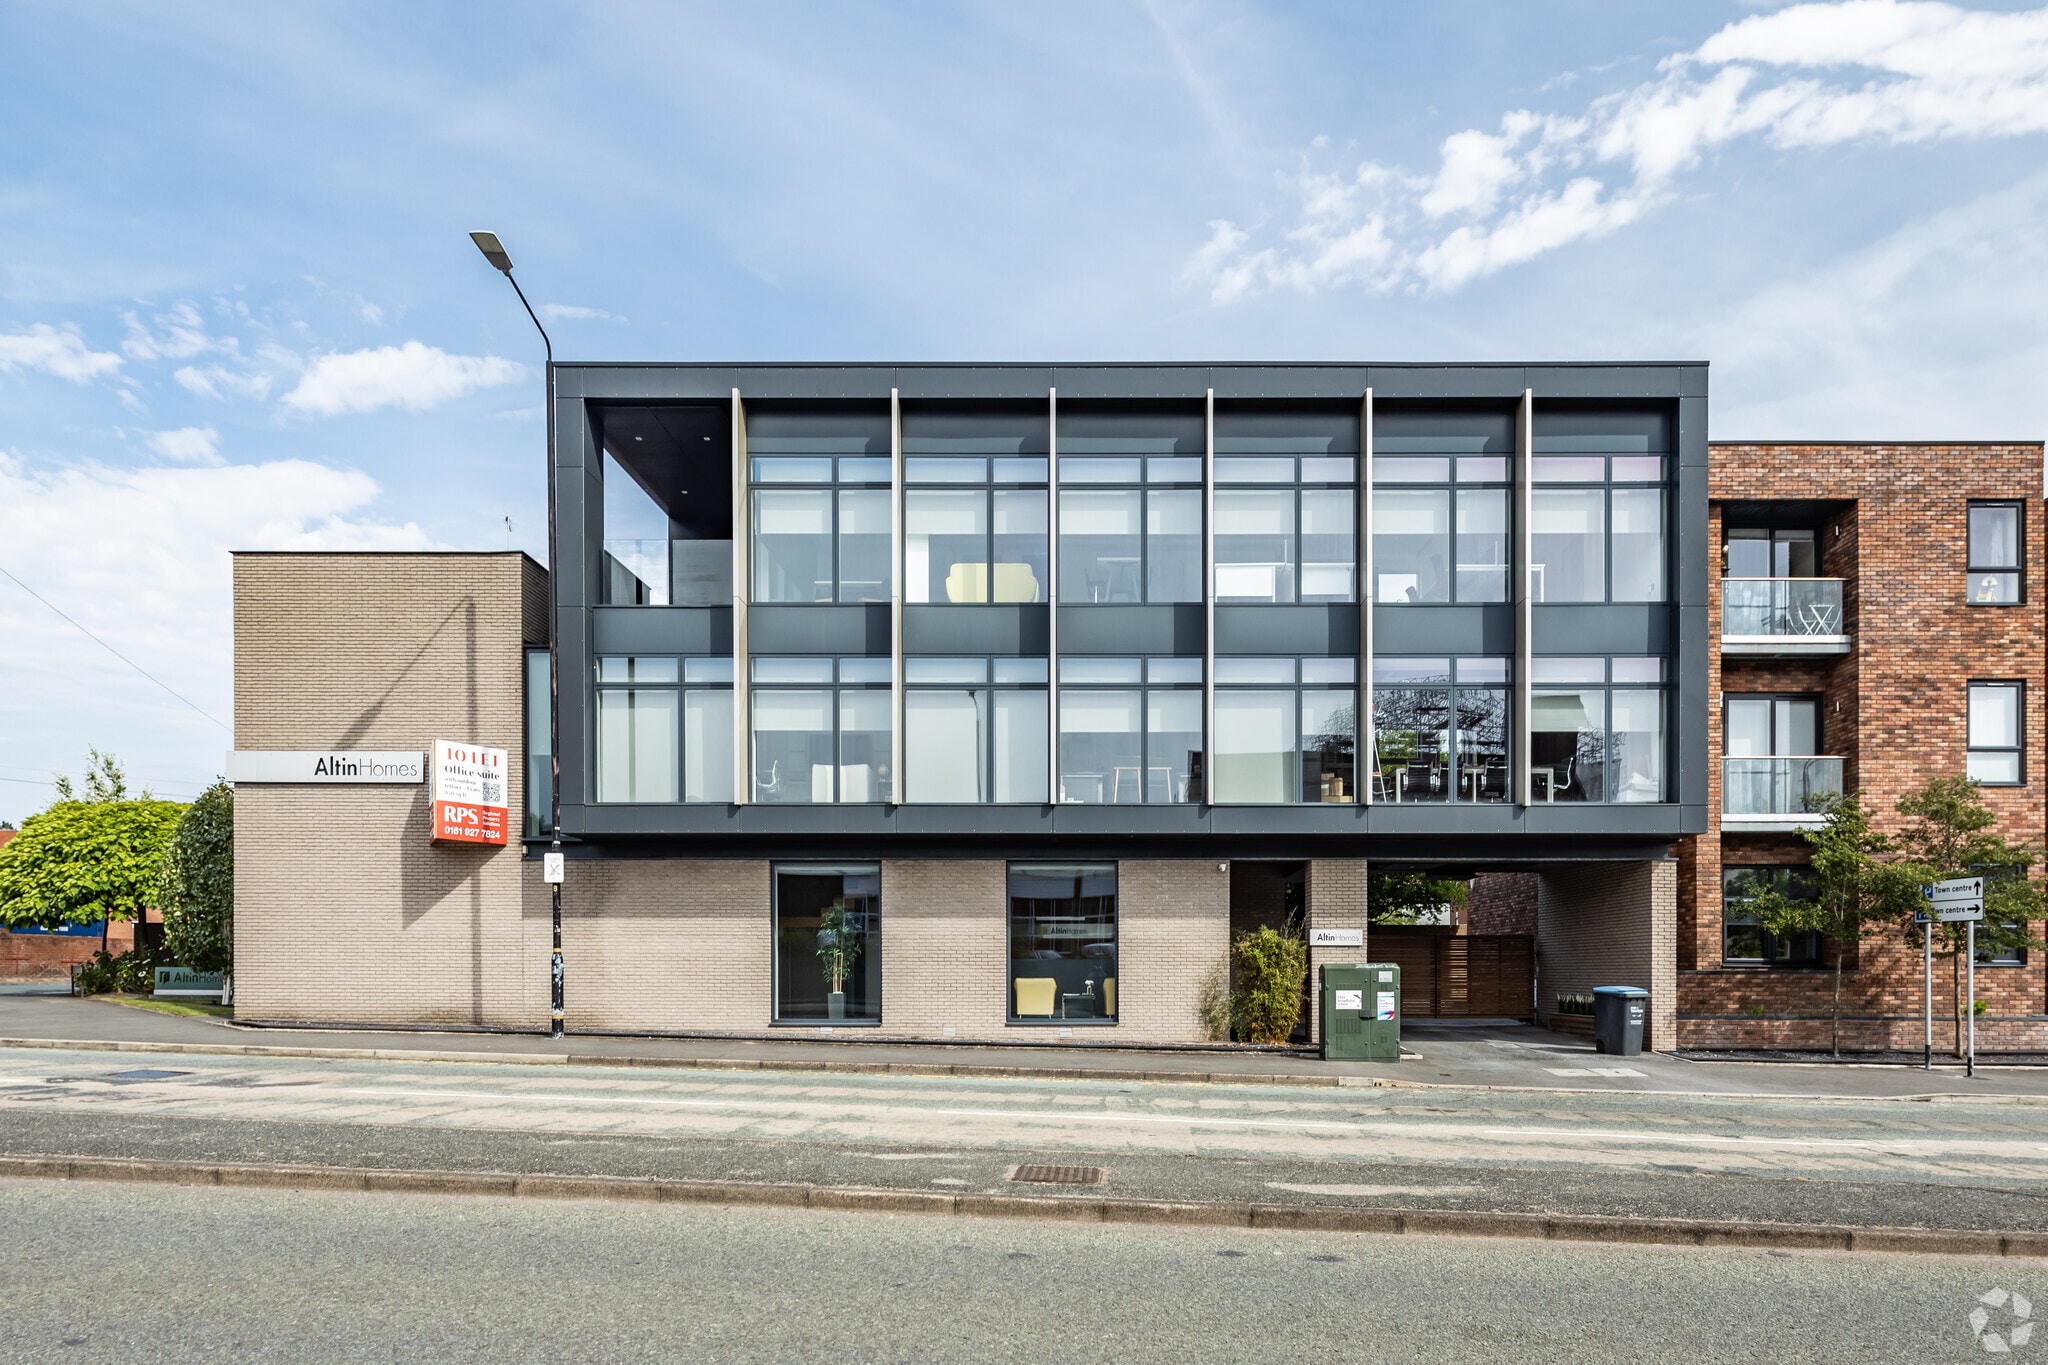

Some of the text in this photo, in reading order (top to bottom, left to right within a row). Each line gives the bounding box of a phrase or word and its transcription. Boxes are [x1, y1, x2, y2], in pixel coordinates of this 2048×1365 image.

[314, 755, 418, 776] AltinHomes
[444, 765, 500, 780] Office suite
[444, 825, 501, 839] 0161 927 7824
[1934, 886, 1951, 894] Town
[1951, 885, 1972, 893] centre
[1945, 906, 1966, 914] centre
[1051, 926, 1087, 935] AltinHomes
[1317, 932, 1360, 942] AltinHomes
